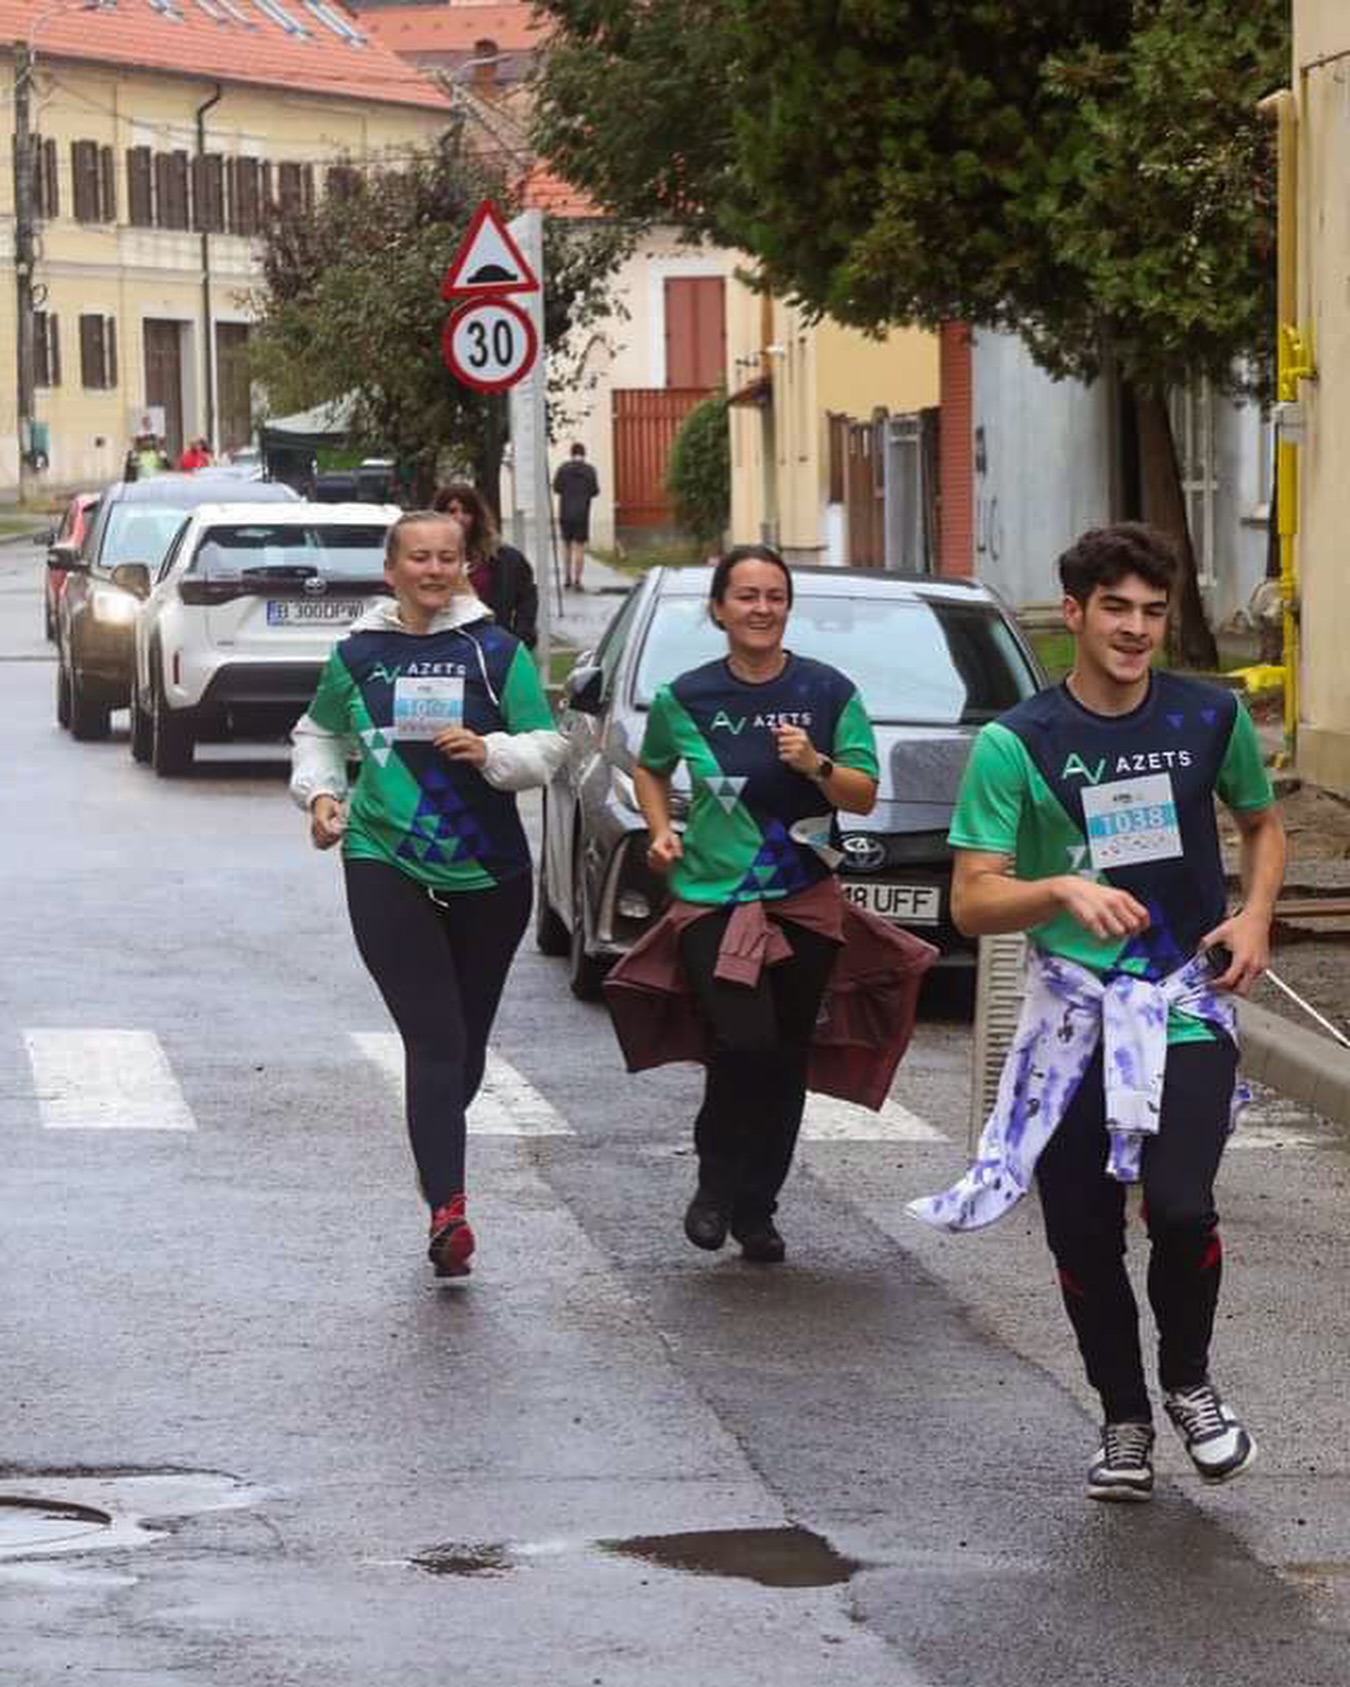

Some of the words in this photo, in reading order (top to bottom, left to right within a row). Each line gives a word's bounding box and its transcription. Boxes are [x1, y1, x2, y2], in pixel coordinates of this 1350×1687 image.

[467, 319, 514, 368] 30
[407, 661, 467, 676] AZETS
[753, 711, 813, 728] AZETS
[1116, 750, 1193, 774] AZETS
[874, 888, 934, 914] UFF
